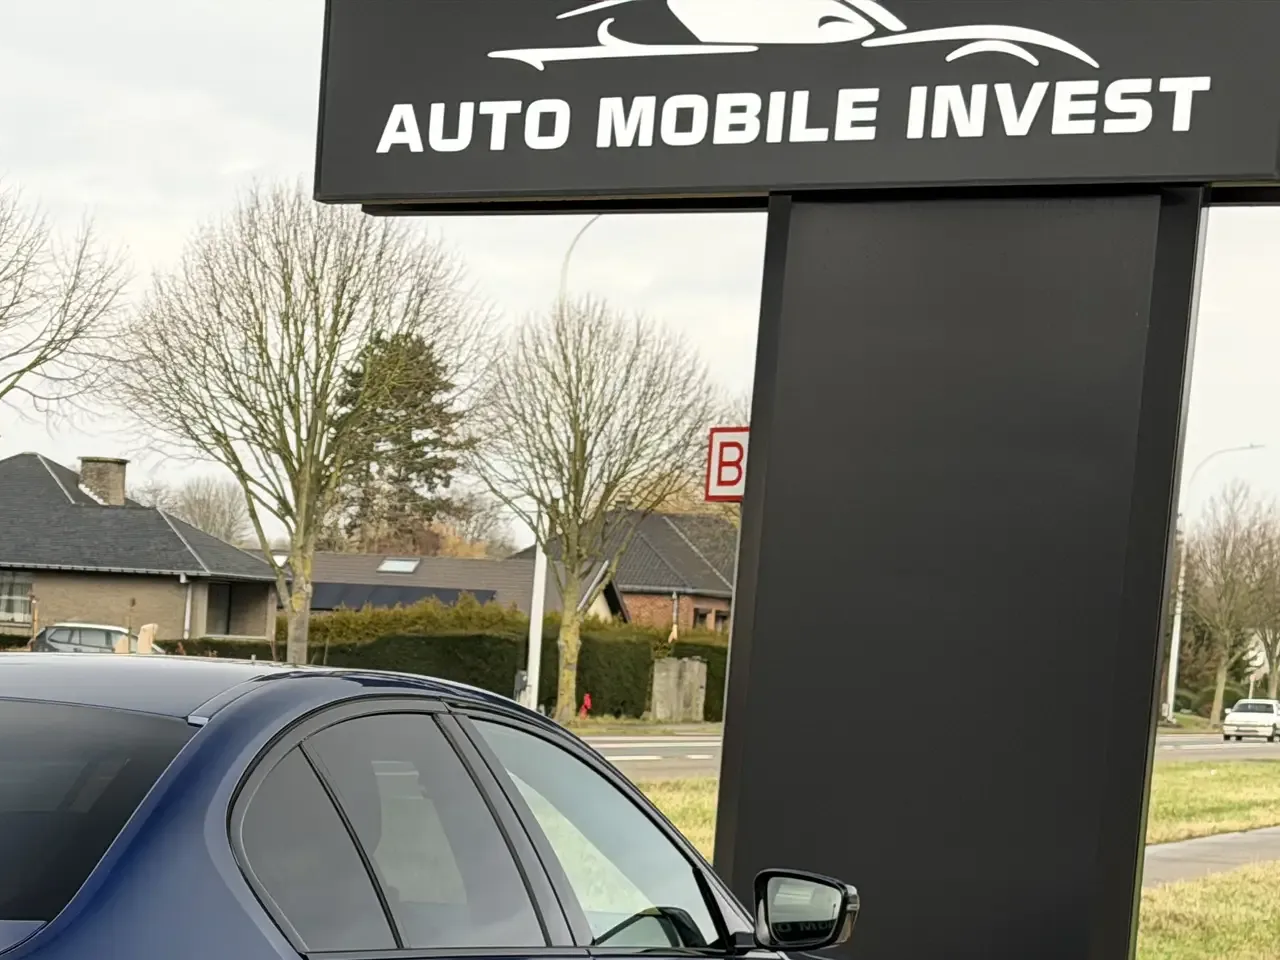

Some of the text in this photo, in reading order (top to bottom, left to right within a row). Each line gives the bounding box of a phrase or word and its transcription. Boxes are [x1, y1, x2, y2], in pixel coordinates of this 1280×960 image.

[376, 76, 1212, 154] AUTO MOBILE INVEST
[716, 441, 744, 487] B
